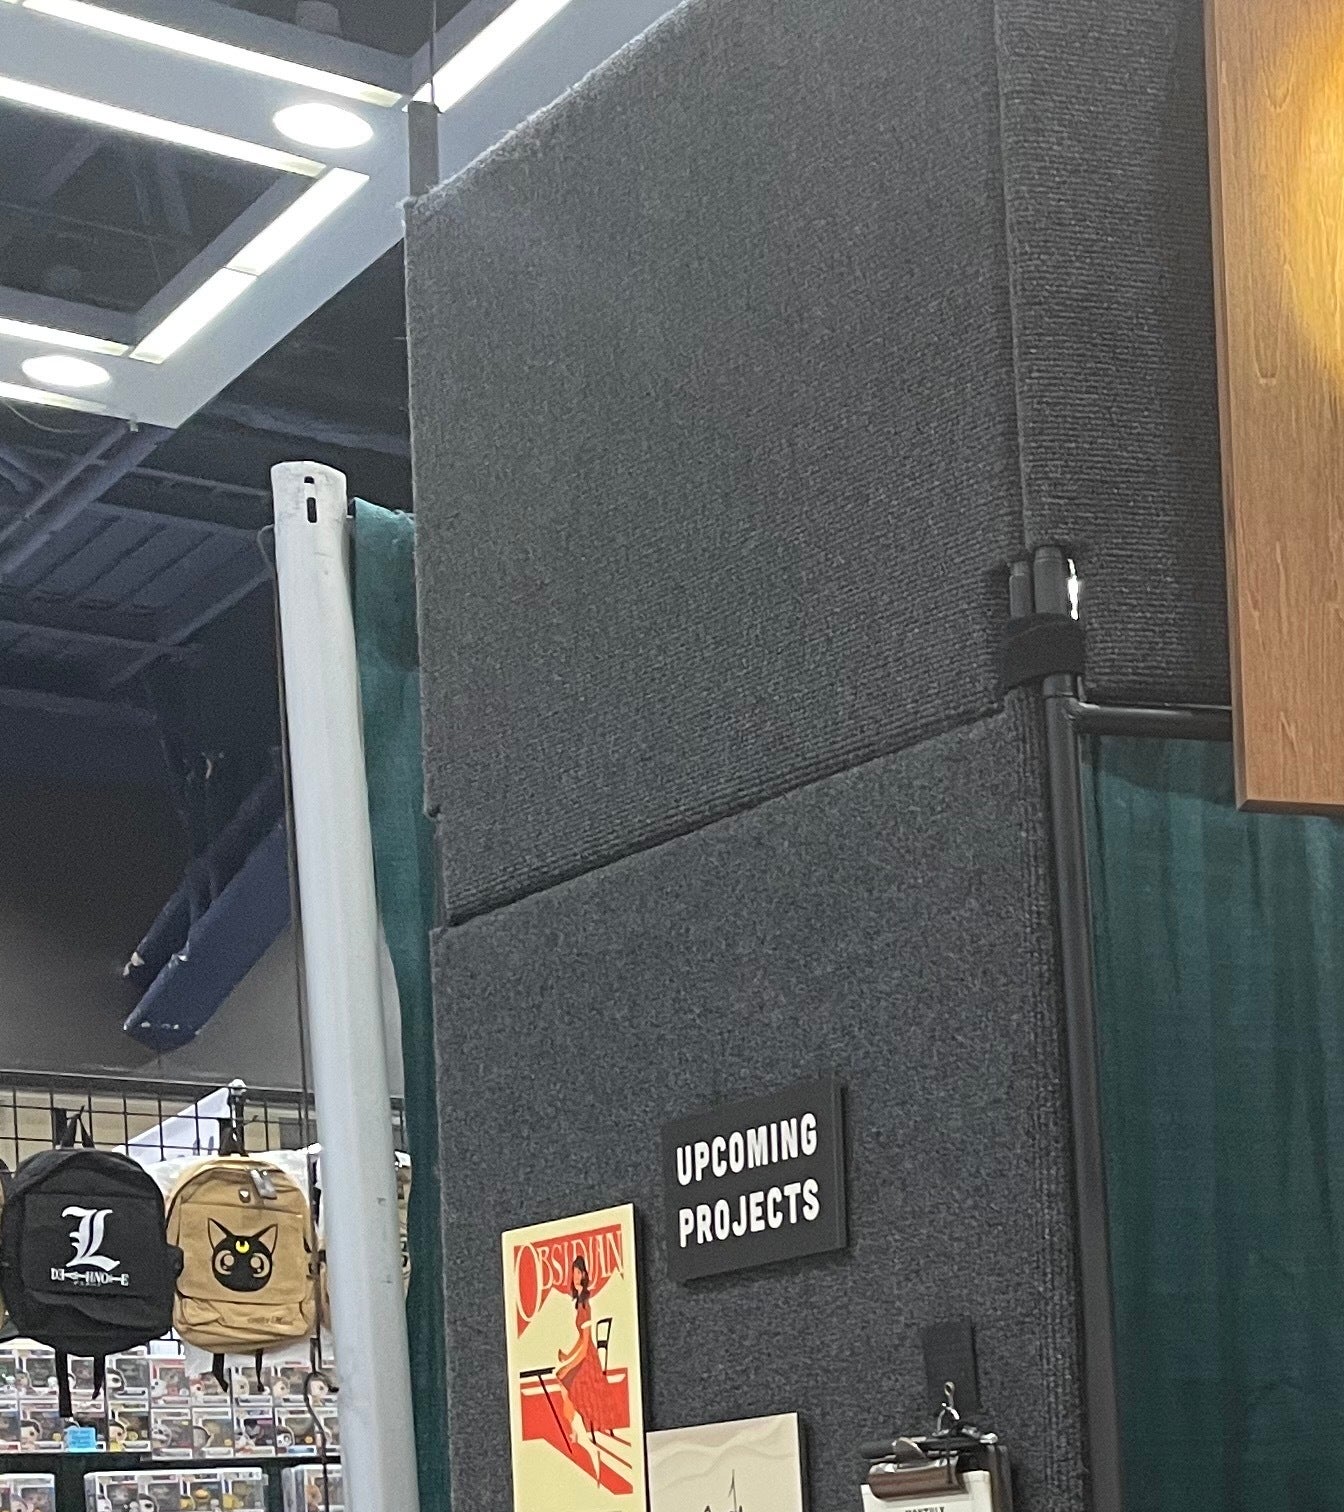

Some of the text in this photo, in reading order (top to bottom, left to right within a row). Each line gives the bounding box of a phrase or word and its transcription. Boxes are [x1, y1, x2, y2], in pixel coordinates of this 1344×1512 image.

[676, 1112, 818, 1186] UPCOMING
[61, 1206, 121, 1272] L
[679, 1178, 820, 1248] PROJECTS
[514, 1231, 625, 1322] OBSIDIAN
